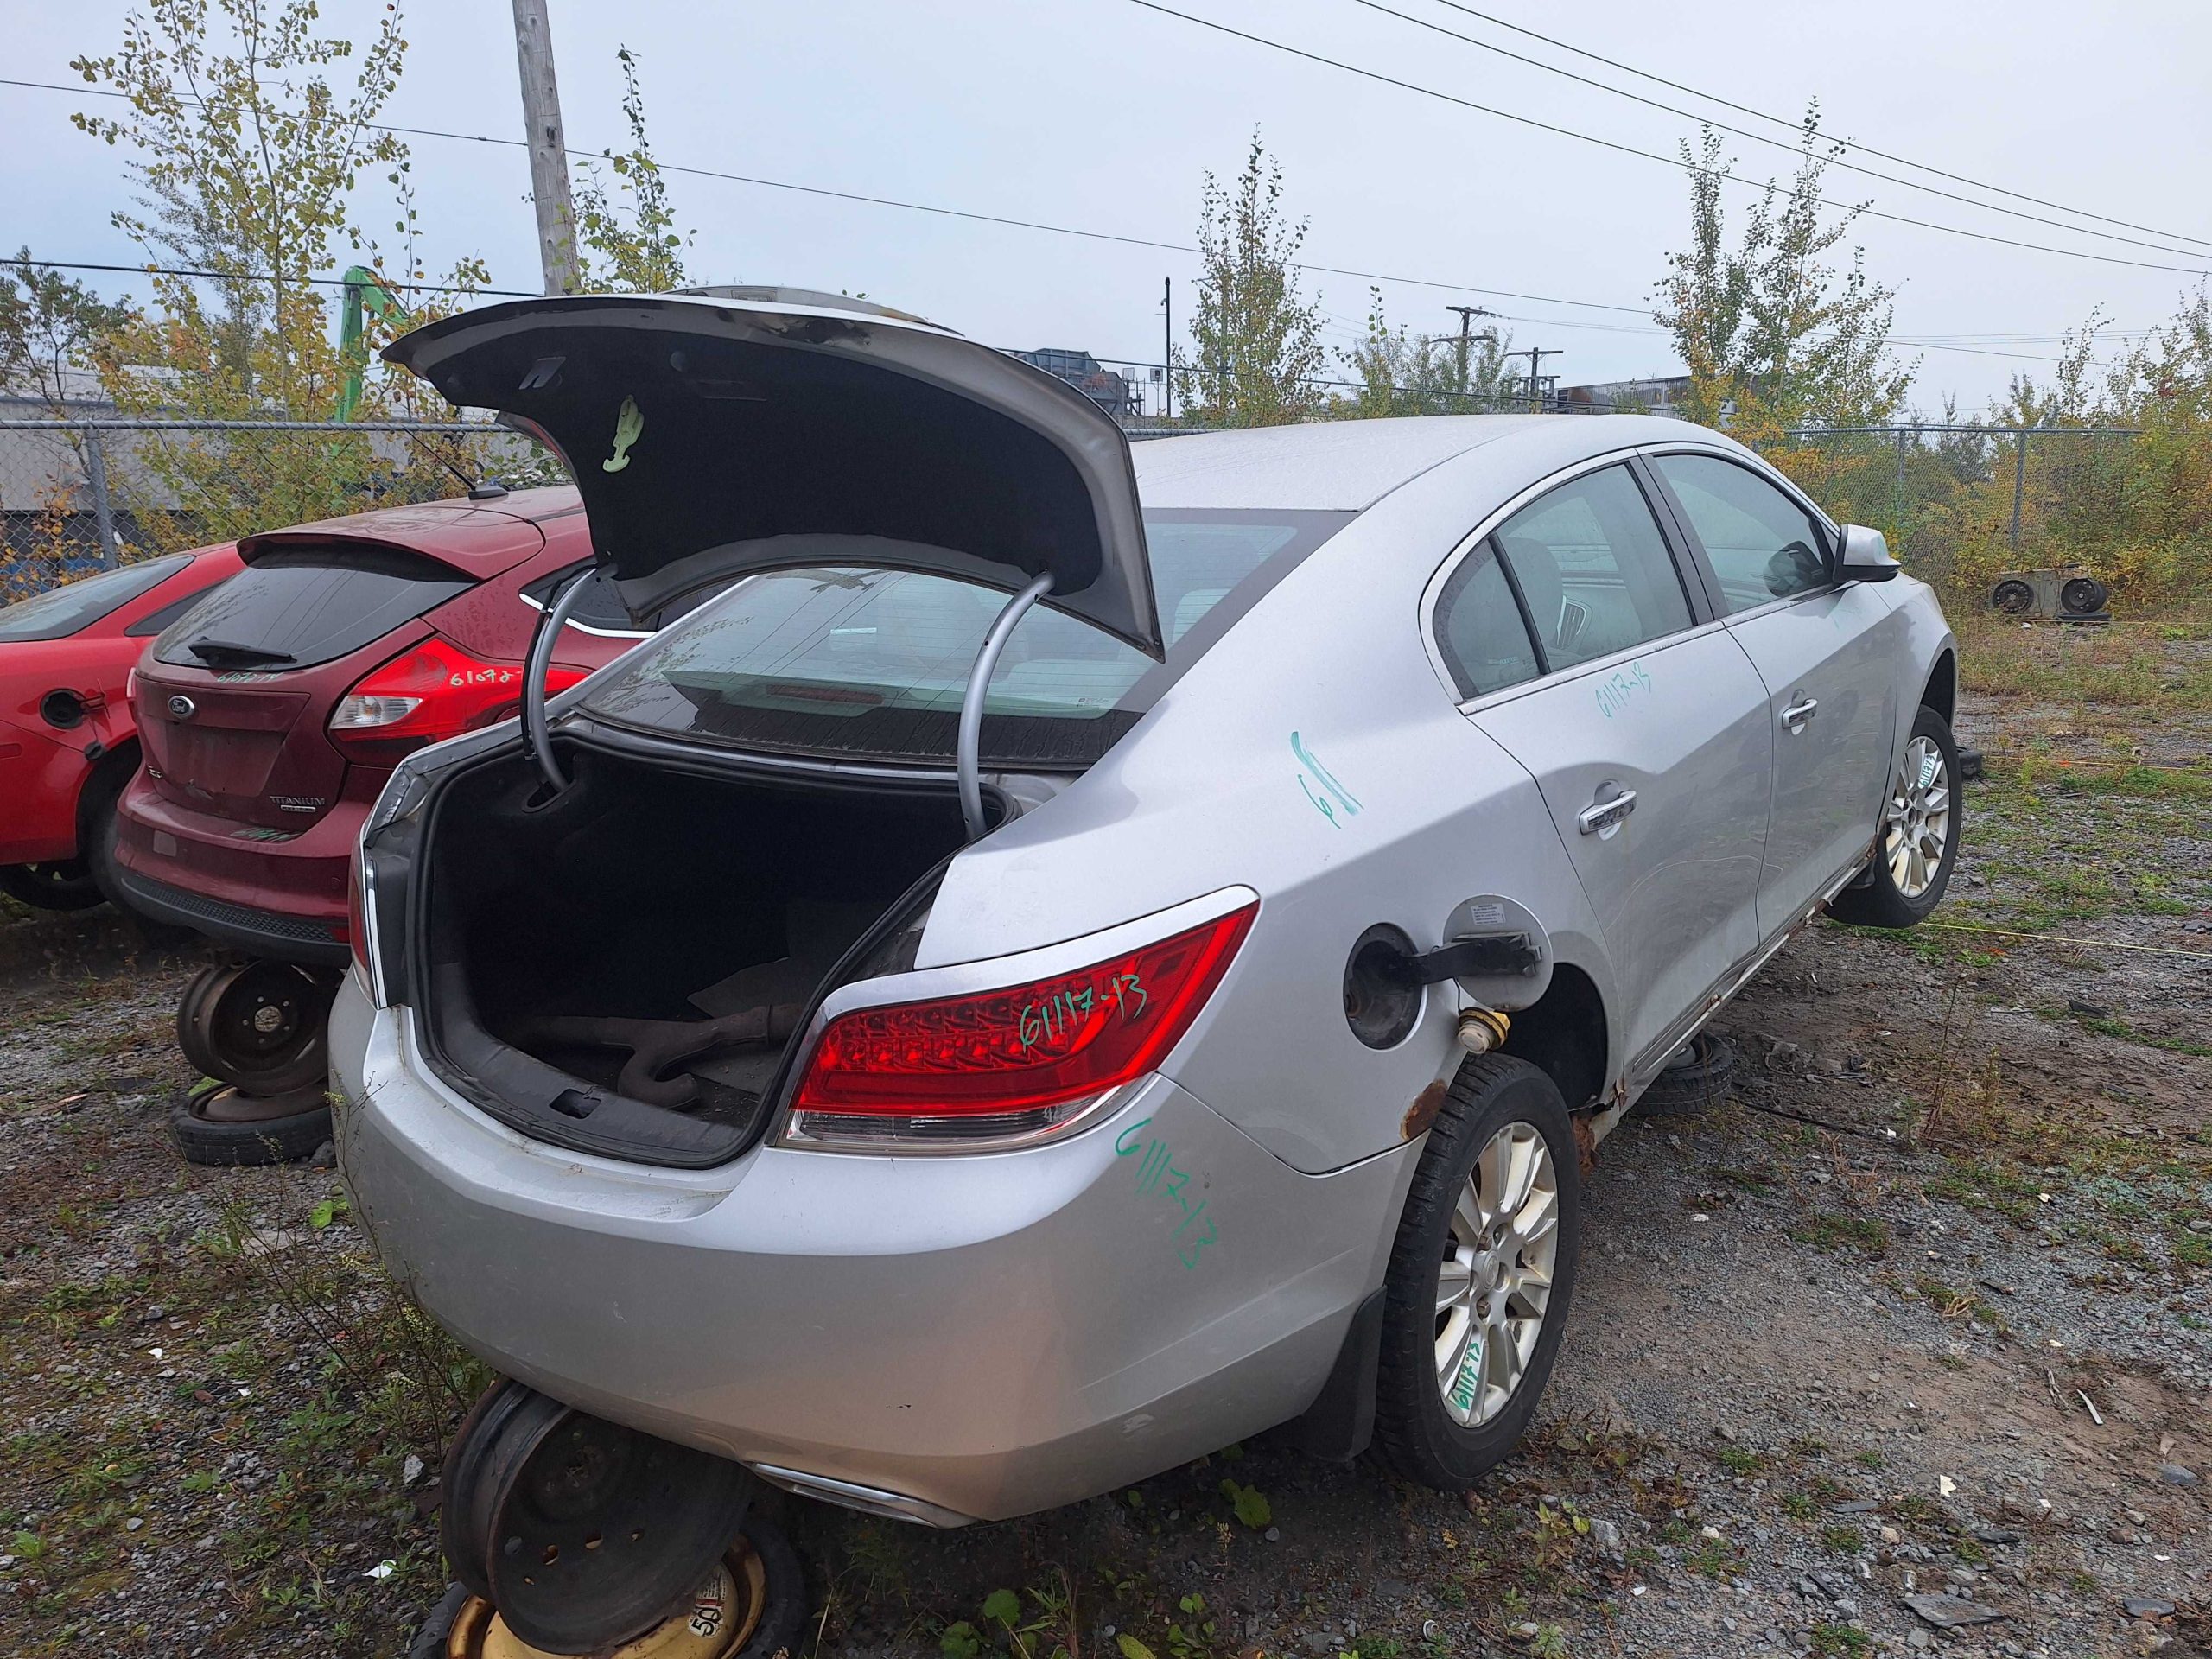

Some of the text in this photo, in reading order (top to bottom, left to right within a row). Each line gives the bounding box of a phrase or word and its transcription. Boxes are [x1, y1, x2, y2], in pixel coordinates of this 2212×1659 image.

[270, 796, 325, 805] TITANIUM
[1020, 974, 1147, 1054] 61117-13
[1116, 1117, 1217, 1270] 61117-13
